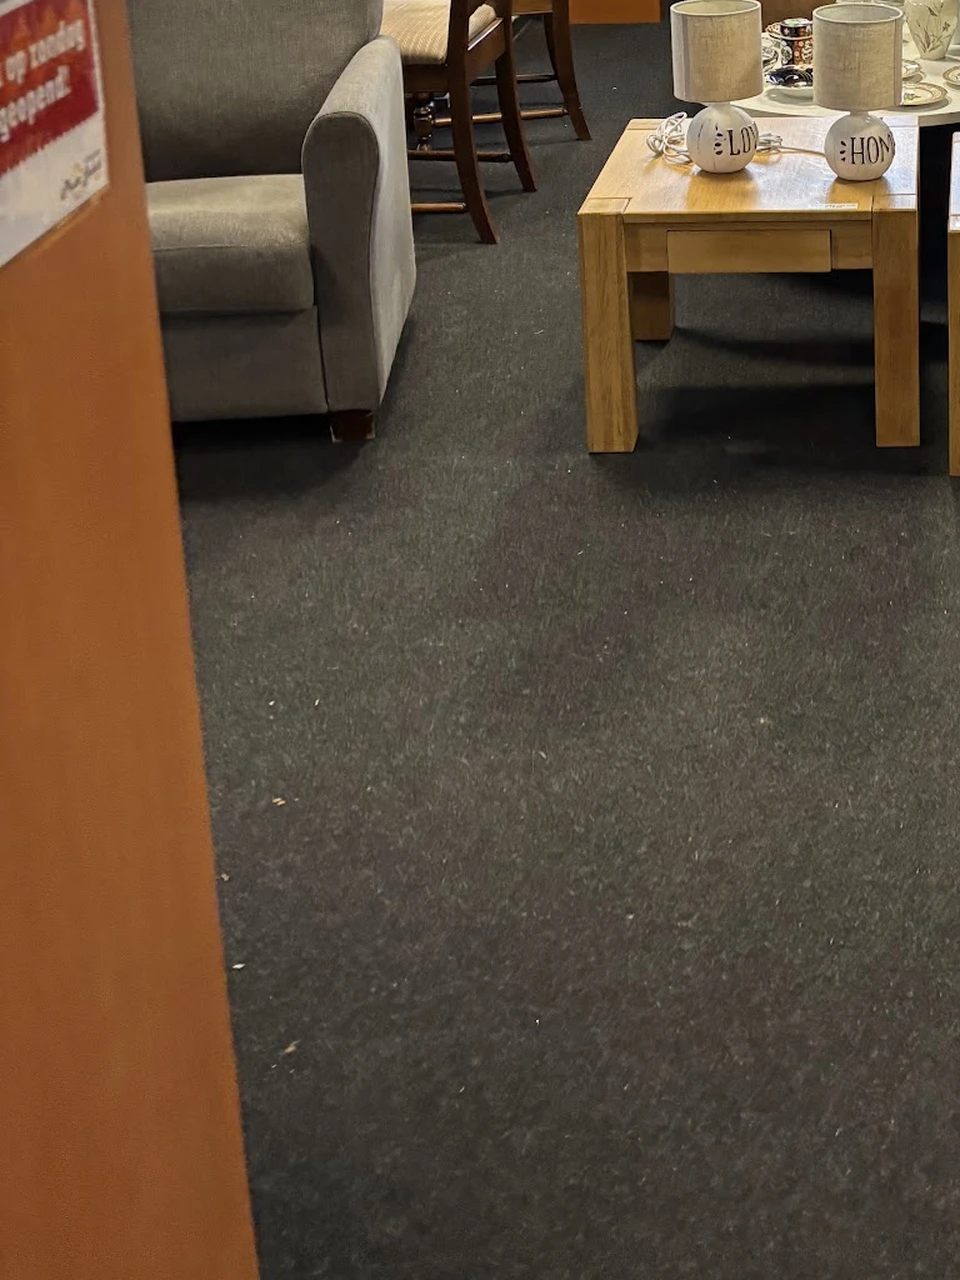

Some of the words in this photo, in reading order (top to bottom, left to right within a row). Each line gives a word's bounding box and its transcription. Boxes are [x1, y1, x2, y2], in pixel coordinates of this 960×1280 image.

[5, 51, 28, 84] op
[28, 19, 86, 70] zondag
[726, 121, 759, 156] LOV
[850, 131, 895, 165] HOM
